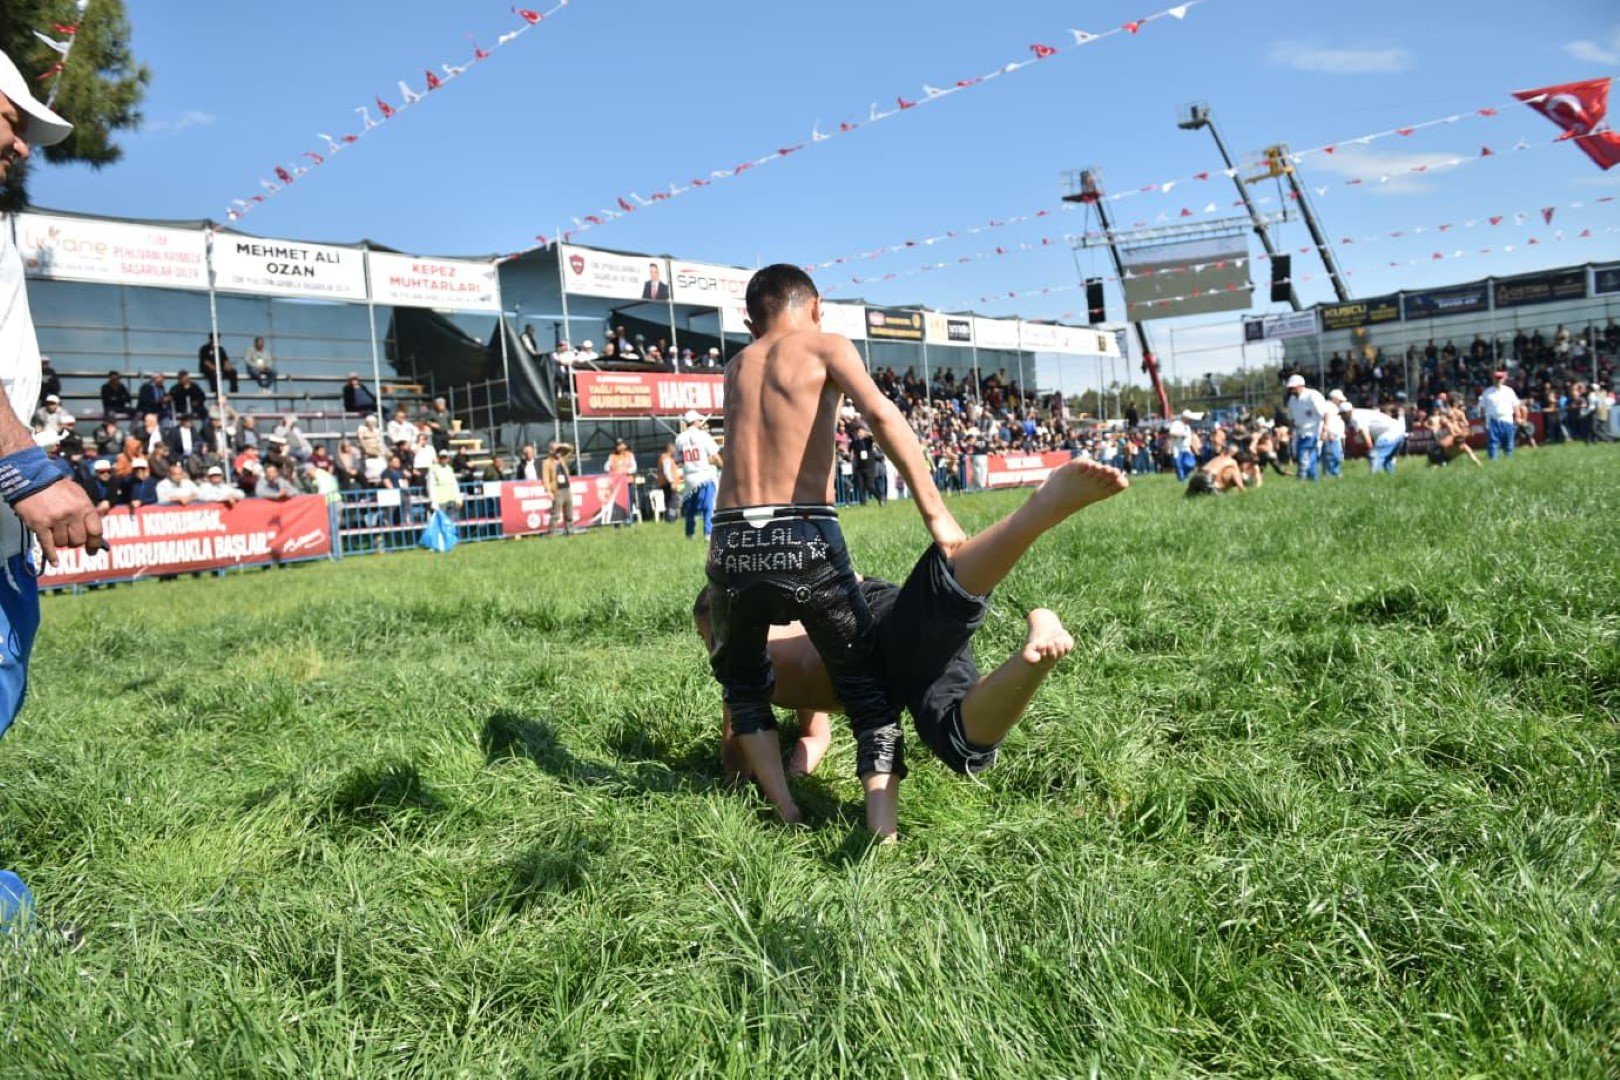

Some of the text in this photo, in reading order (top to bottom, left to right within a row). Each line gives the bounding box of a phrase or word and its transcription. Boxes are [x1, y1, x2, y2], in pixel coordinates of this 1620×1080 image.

[236, 243, 308, 261] MEHMET
[266, 262, 315, 277] OZAN
[412, 263, 456, 278] KEPEZ
[389, 276, 481, 293] MUHTARLARI
[677, 274, 748, 294] SPORTOT
[726, 527, 802, 549] CELAL
[112, 537, 213, 569] KORUMAKLA
[725, 550, 804, 574] ARIKAN
